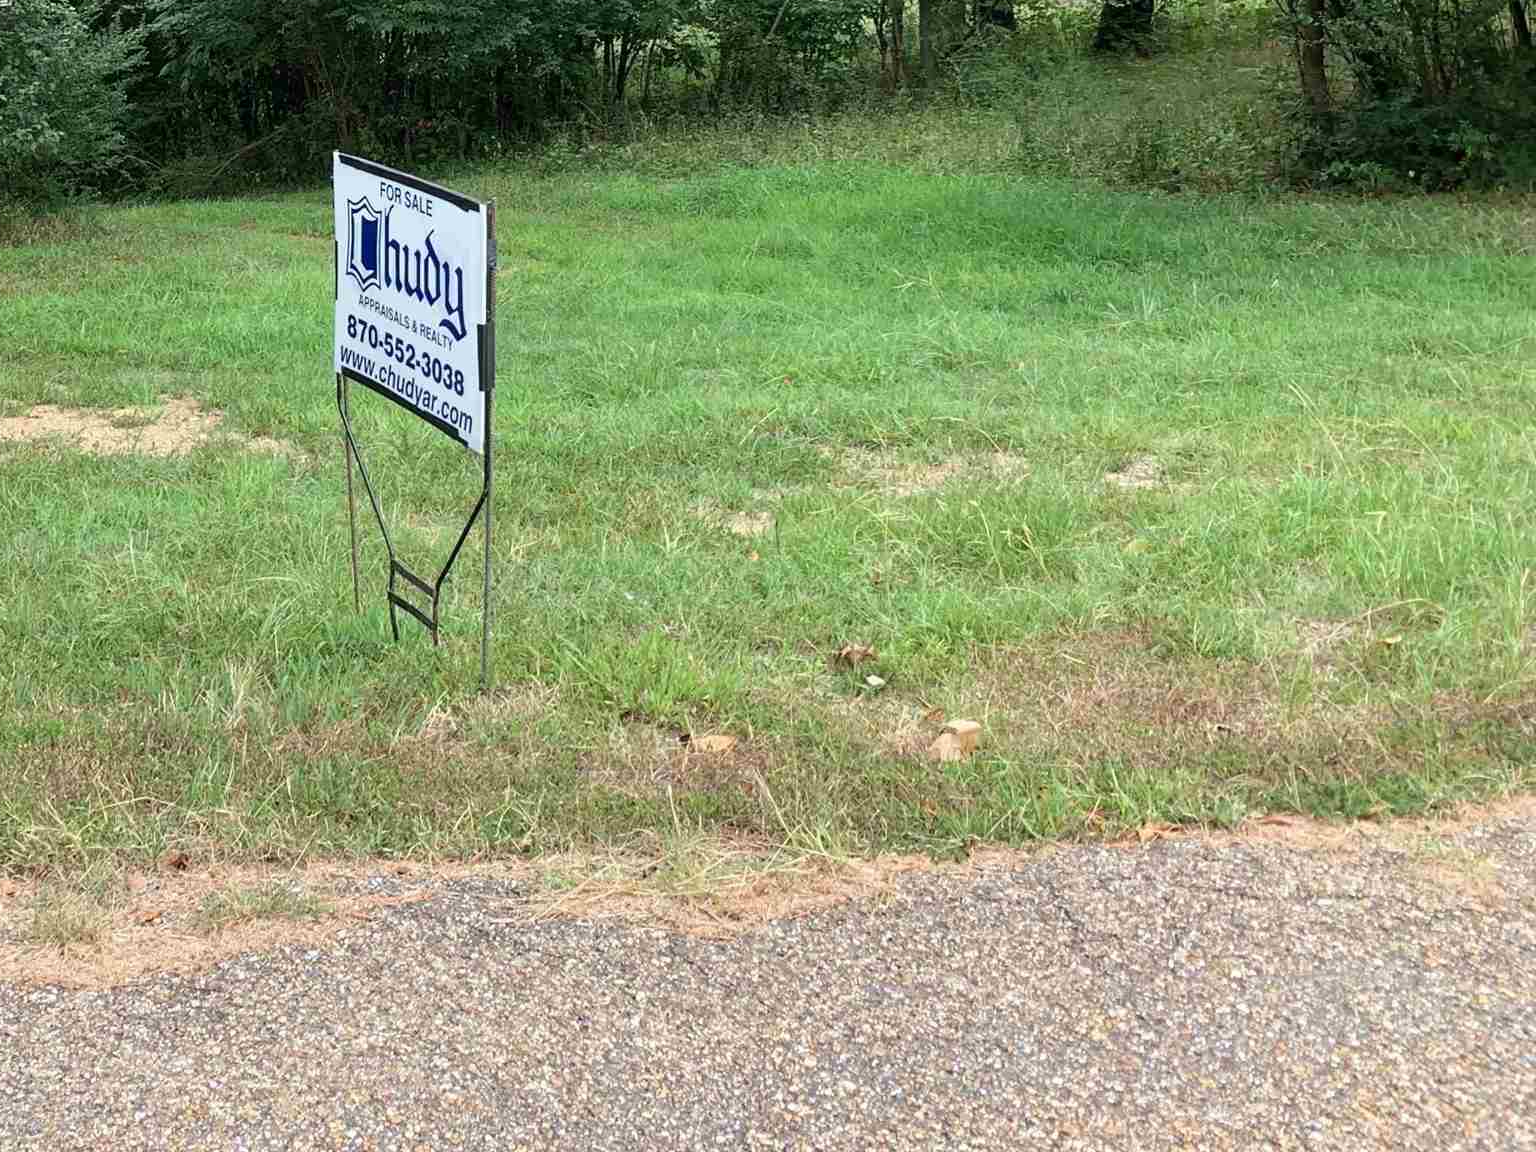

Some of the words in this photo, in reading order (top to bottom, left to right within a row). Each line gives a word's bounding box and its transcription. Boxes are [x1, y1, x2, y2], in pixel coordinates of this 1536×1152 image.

[380, 182, 402, 205] FOR
[404, 191, 433, 217] SALE
[346, 196, 467, 341] Chudy
[347, 314, 465, 397] 870-552-3038
[358, 294, 410, 328] APPRAISALS
[411, 321, 418, 333] &
[420, 324, 454, 351] REALTY
[340, 345, 473, 434] www.chudyar.com
